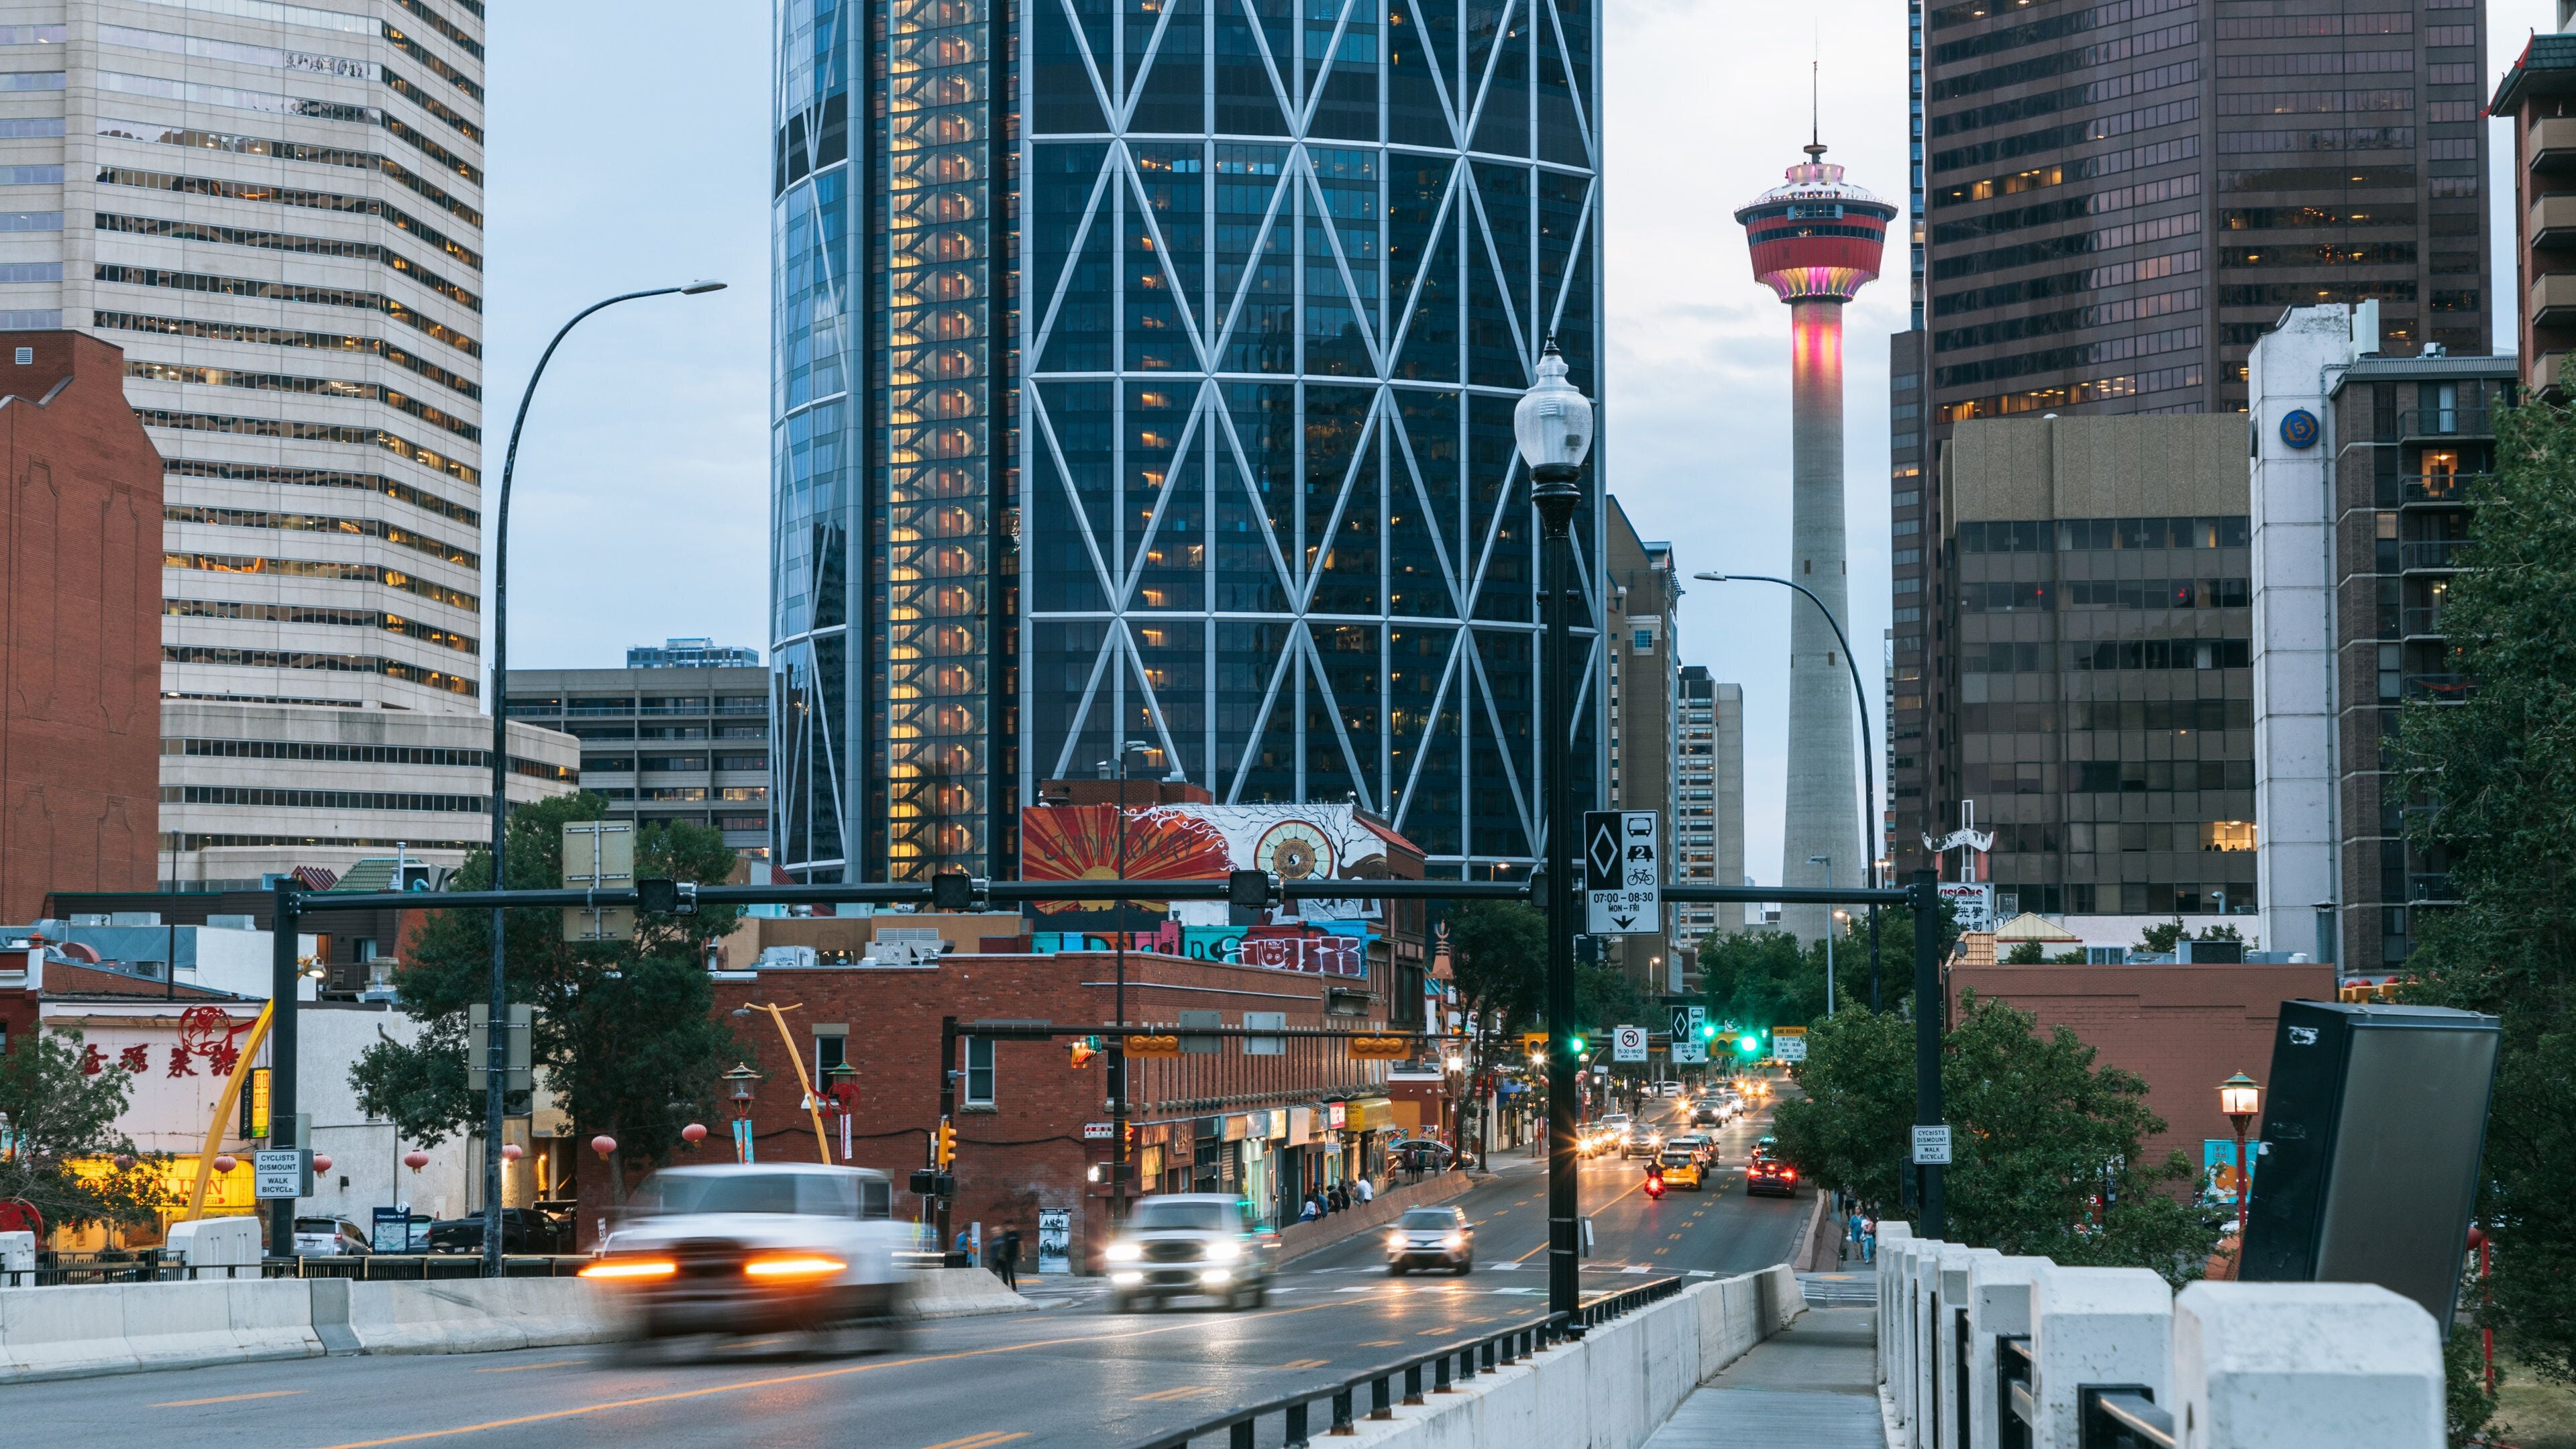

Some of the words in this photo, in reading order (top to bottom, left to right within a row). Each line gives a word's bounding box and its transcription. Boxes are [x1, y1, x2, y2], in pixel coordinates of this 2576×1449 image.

[2294, 421, 2306, 435] 5
[1635, 847, 1645, 858] 2
[1594, 894, 1618, 903] 07:00
[1628, 892, 1654, 902] 08:30
